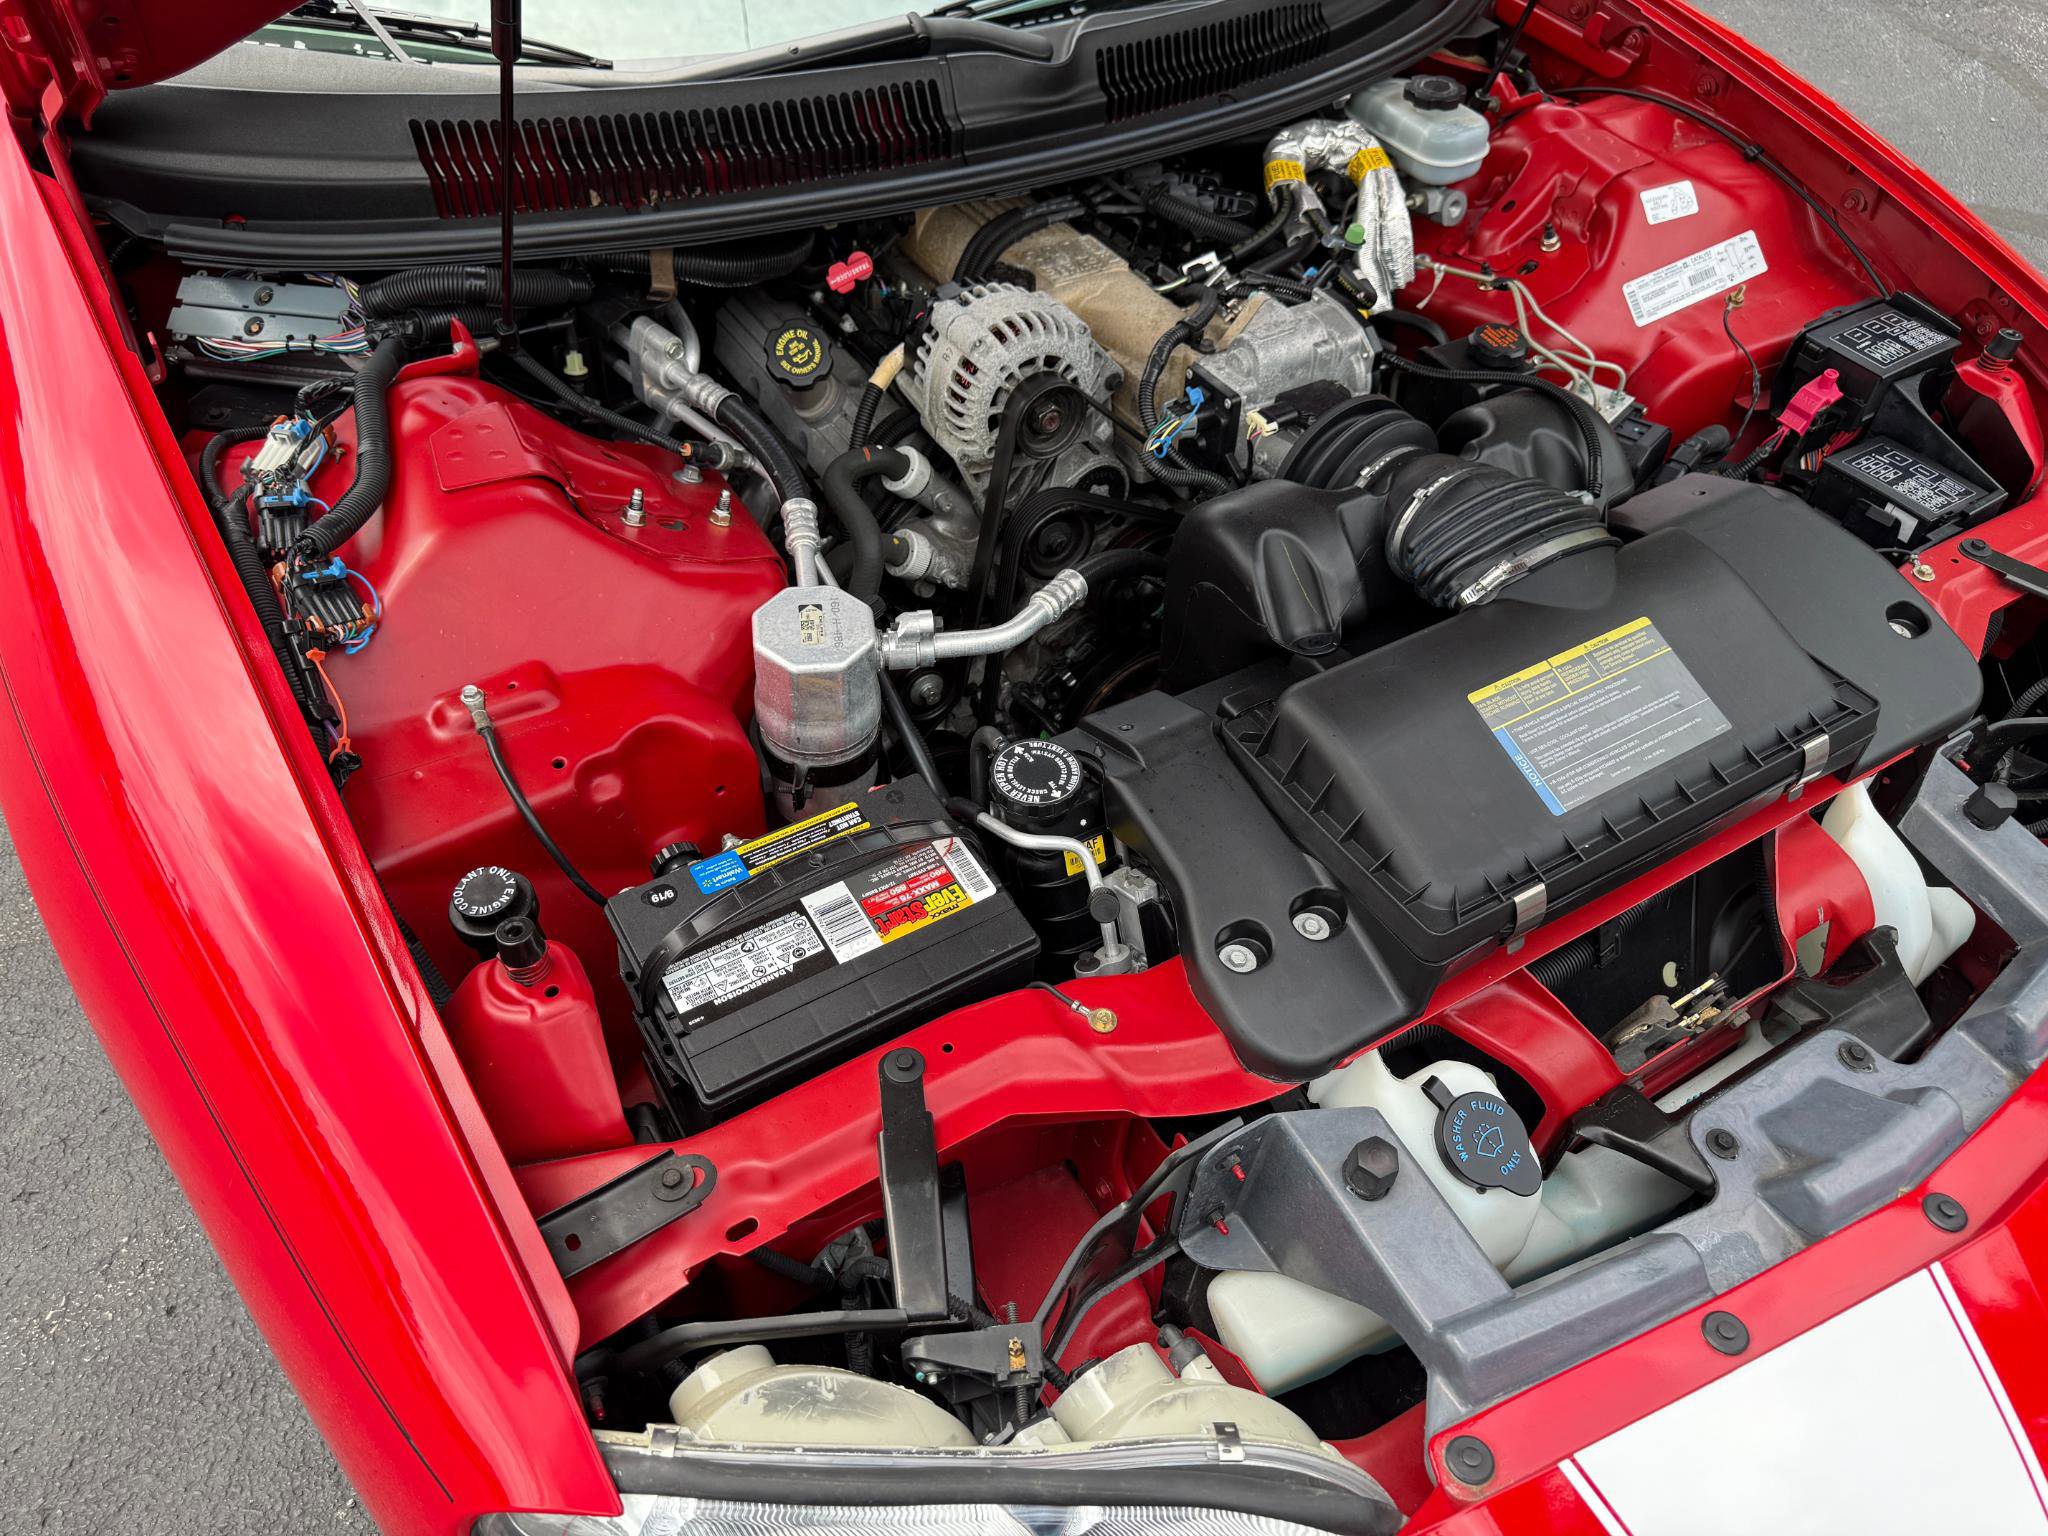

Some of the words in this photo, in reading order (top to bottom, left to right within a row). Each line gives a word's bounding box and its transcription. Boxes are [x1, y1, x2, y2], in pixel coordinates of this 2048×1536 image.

[776, 330, 796, 355] ENGINE
[797, 329, 808, 340] OIL
[1500, 676, 1521, 688] CAUTION
[996, 757, 1008, 771] HOT
[1007, 756, 1020, 772] BOTTLE
[1513, 752, 1542, 786] NOTICE
[996, 773, 1012, 791] OPEN
[1011, 779, 1026, 791] LEVEL
[1010, 789, 1040, 802] NEVER
[828, 810, 861, 828] STARTING?
[836, 821, 849, 832] NOT
[849, 817, 861, 827] CAR
[712, 866, 743, 883] Walmart
[453, 867, 485, 910] COOLANT
[489, 866, 516, 885] ONLY
[650, 885, 675, 903] 9/19
[469, 888, 515, 914] ENGINE
[874, 883, 967, 936] EverStart
[930, 904, 959, 920] maxx
[714, 969, 787, 1006] DANGER/POISON
[1452, 1109, 1468, 1162] WASHER
[1470, 1100, 1504, 1116] FLUID
[1500, 1150, 1521, 1175] ONLY
